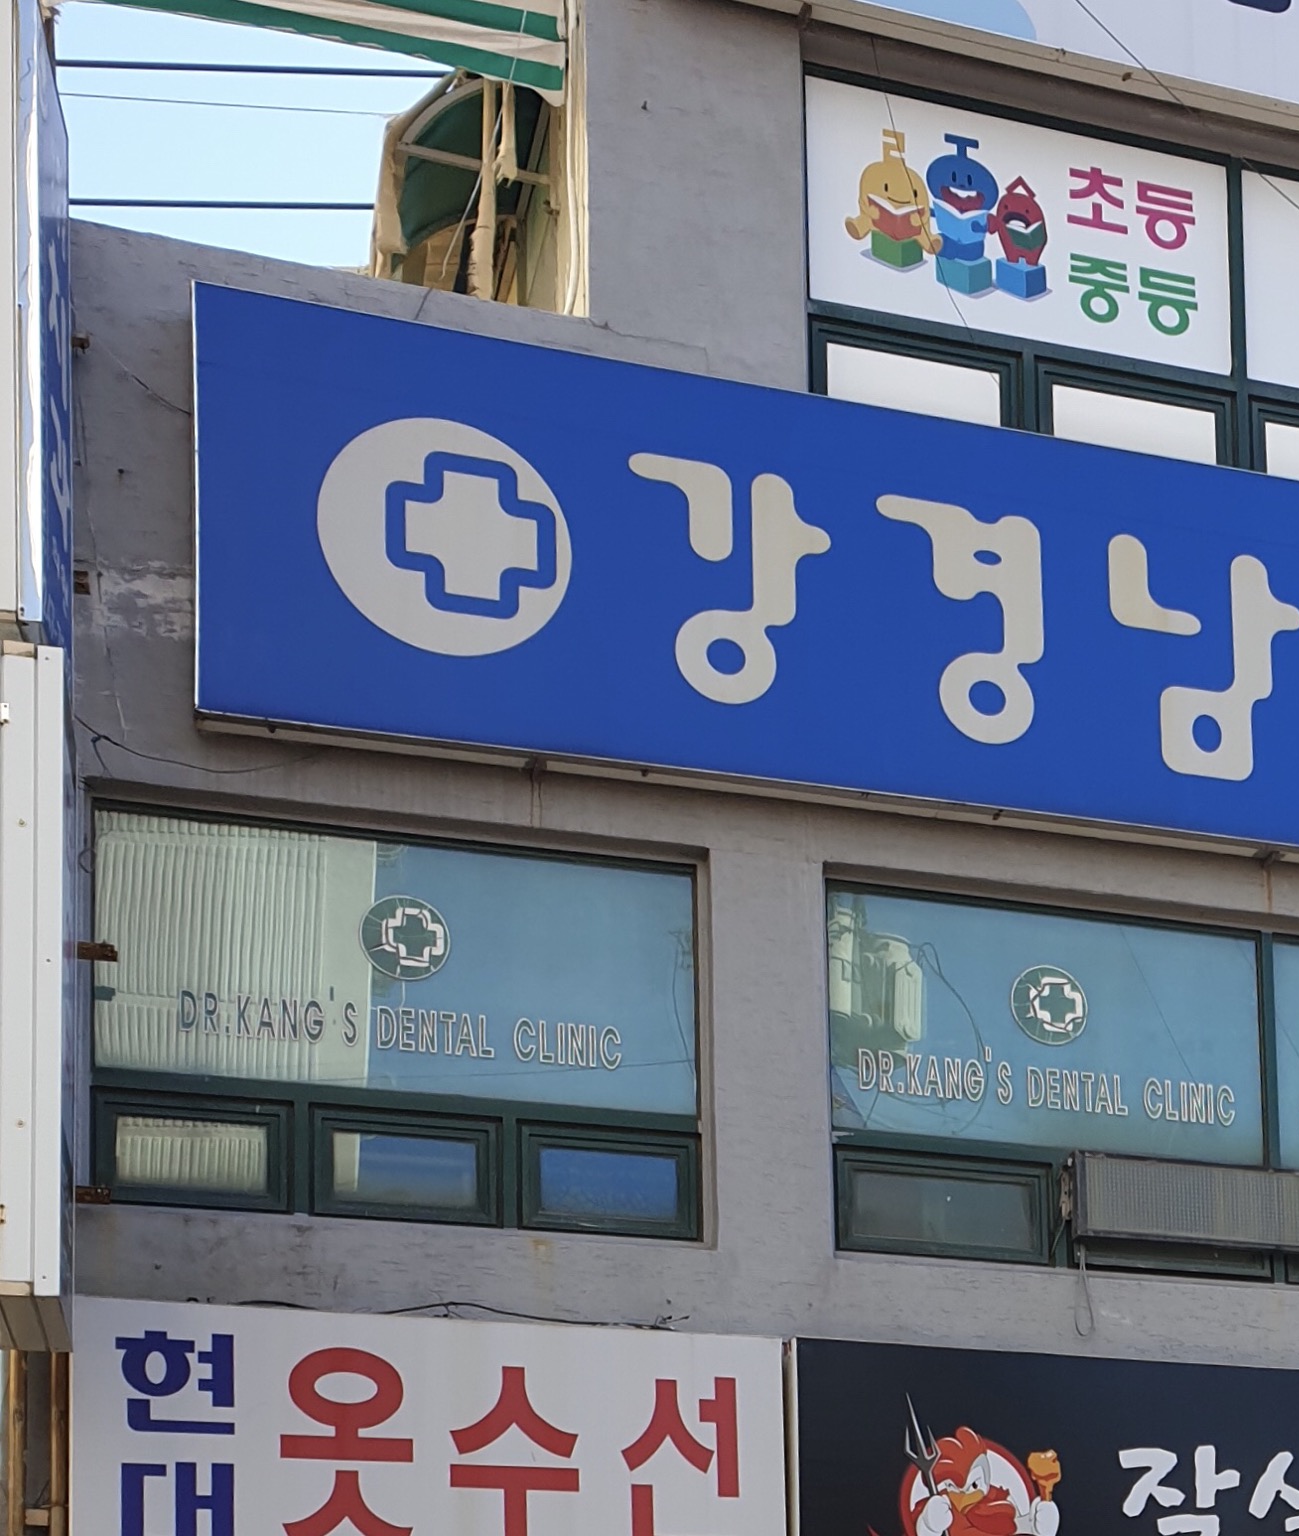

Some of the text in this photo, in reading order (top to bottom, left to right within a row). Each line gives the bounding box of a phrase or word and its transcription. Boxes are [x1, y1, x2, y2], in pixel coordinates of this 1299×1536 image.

[1066, 166, 1194, 251] 초등
[1068, 253, 1198, 336] 중등
[376, 1005, 495, 1059] DENTAL
[513, 1018, 622, 1070] CLINIC
[1026, 1066, 1129, 1116] DENTAL
[1143, 1078, 1236, 1127] CLINIC
